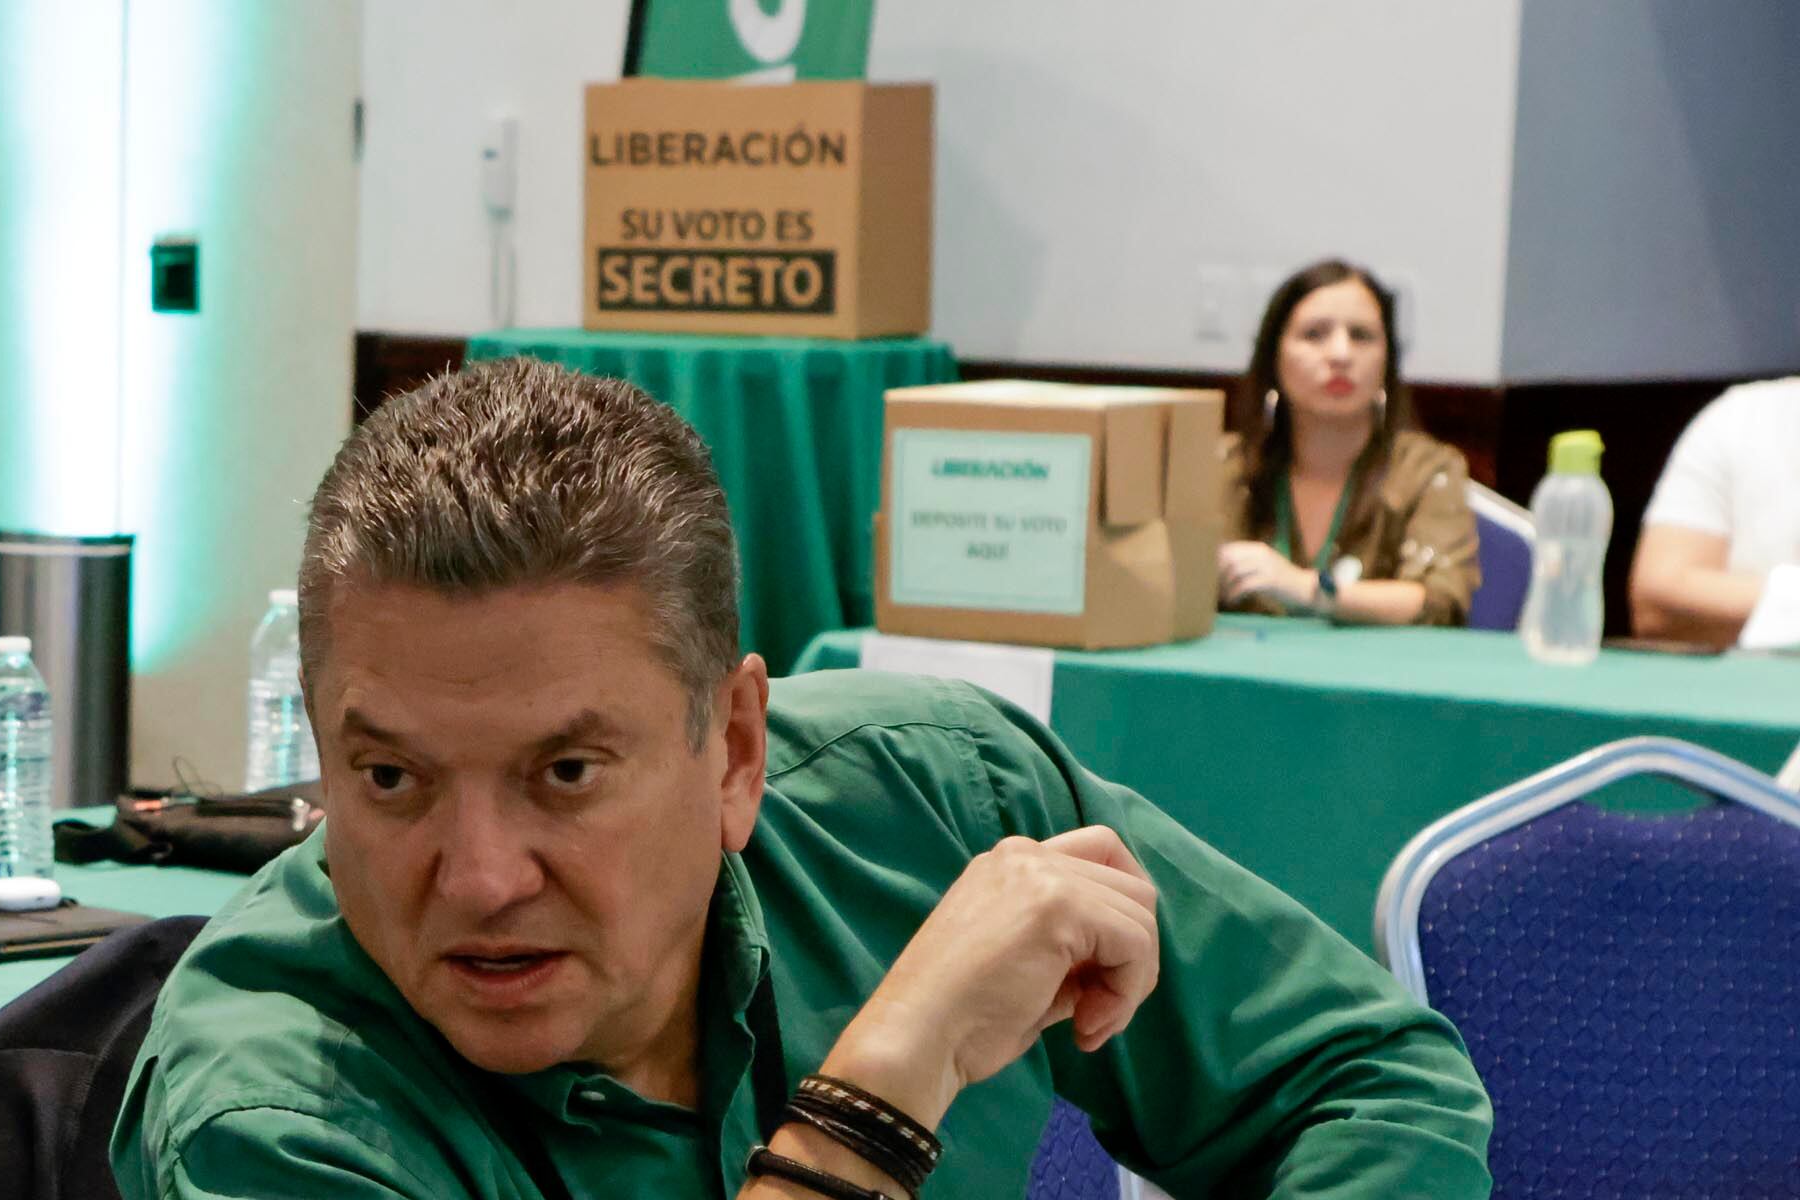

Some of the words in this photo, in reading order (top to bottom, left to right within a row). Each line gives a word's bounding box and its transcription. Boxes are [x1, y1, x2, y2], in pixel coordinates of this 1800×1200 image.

[590, 122, 847, 167] LIBERACIÓN
[621, 208, 663, 240] SU
[672, 209, 767, 241] VOTO
[775, 210, 814, 241] ES
[600, 253, 824, 307] SECRETO
